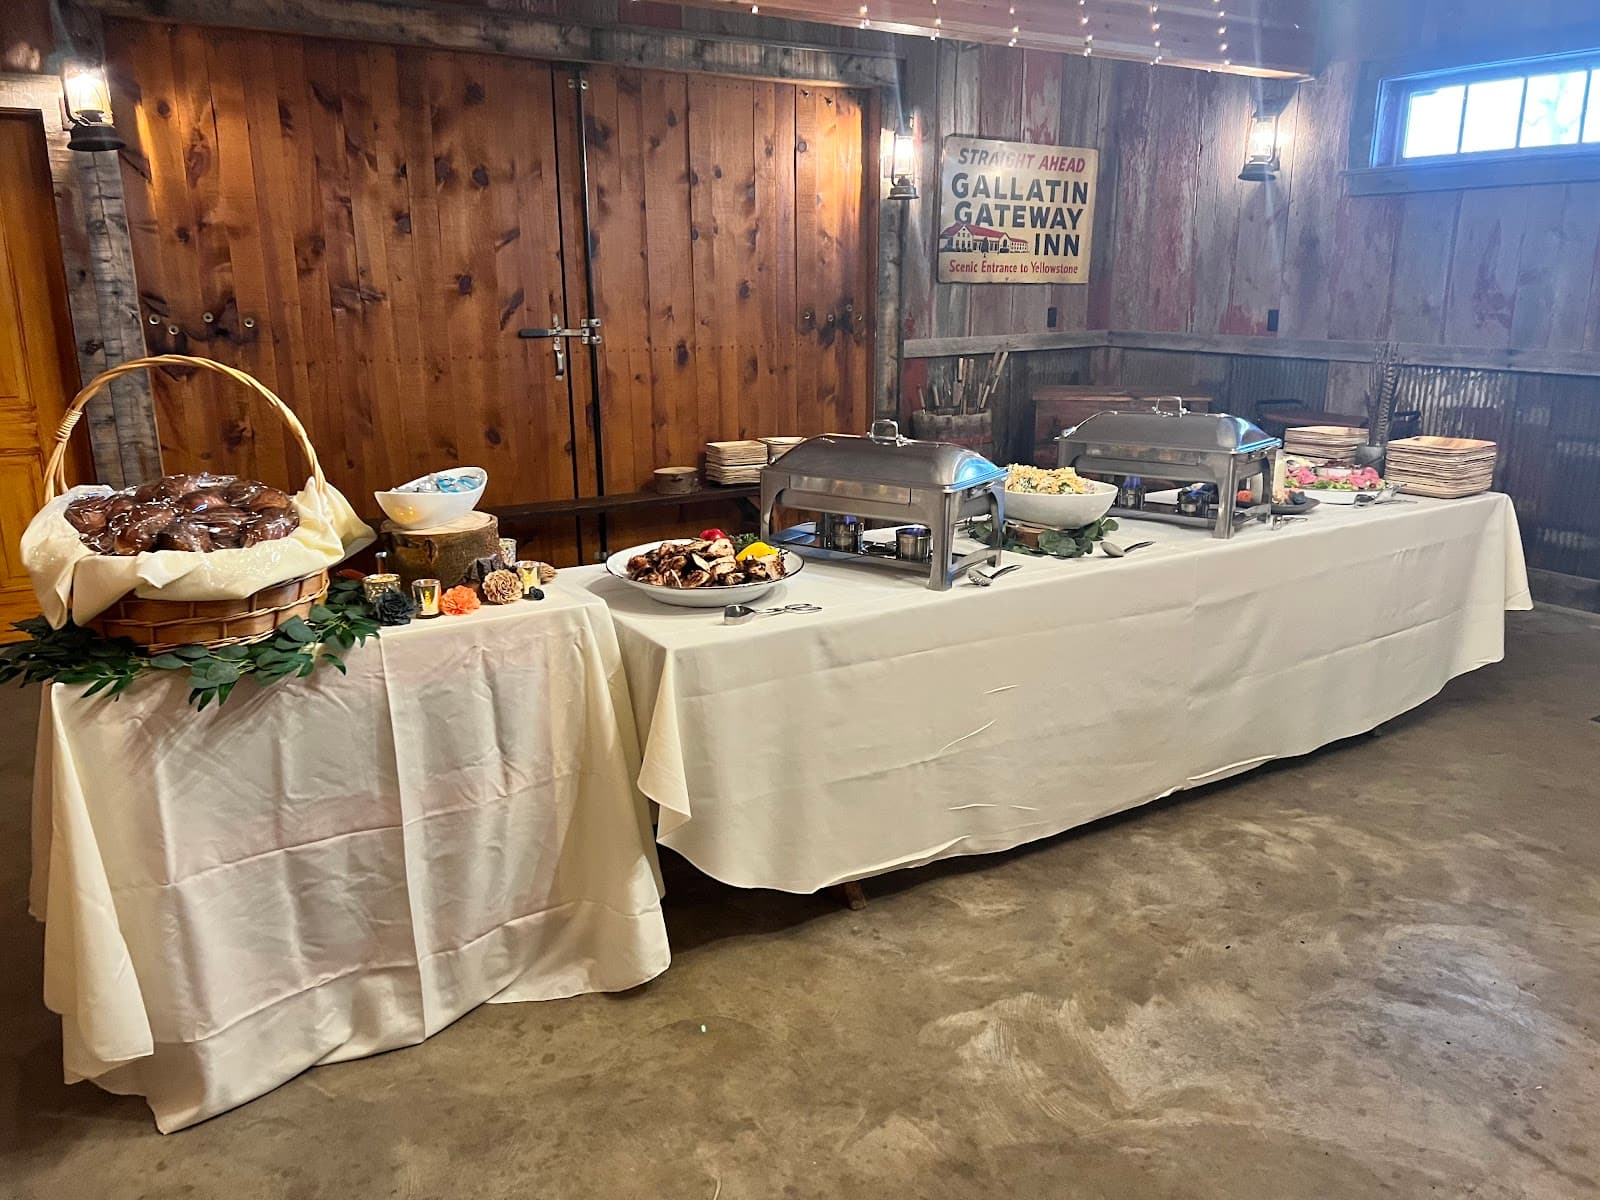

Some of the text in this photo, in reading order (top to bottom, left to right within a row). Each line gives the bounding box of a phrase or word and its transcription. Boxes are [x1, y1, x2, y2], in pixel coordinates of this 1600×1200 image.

[958, 148, 1086, 173] STRAIGHT AHEAD
[951, 172, 1089, 205] GALLATIN
[954, 201, 1084, 230] GATEWAY
[1034, 233, 1080, 257] INN
[949, 260, 1079, 274] Scenic Entrance to Yellowstone
